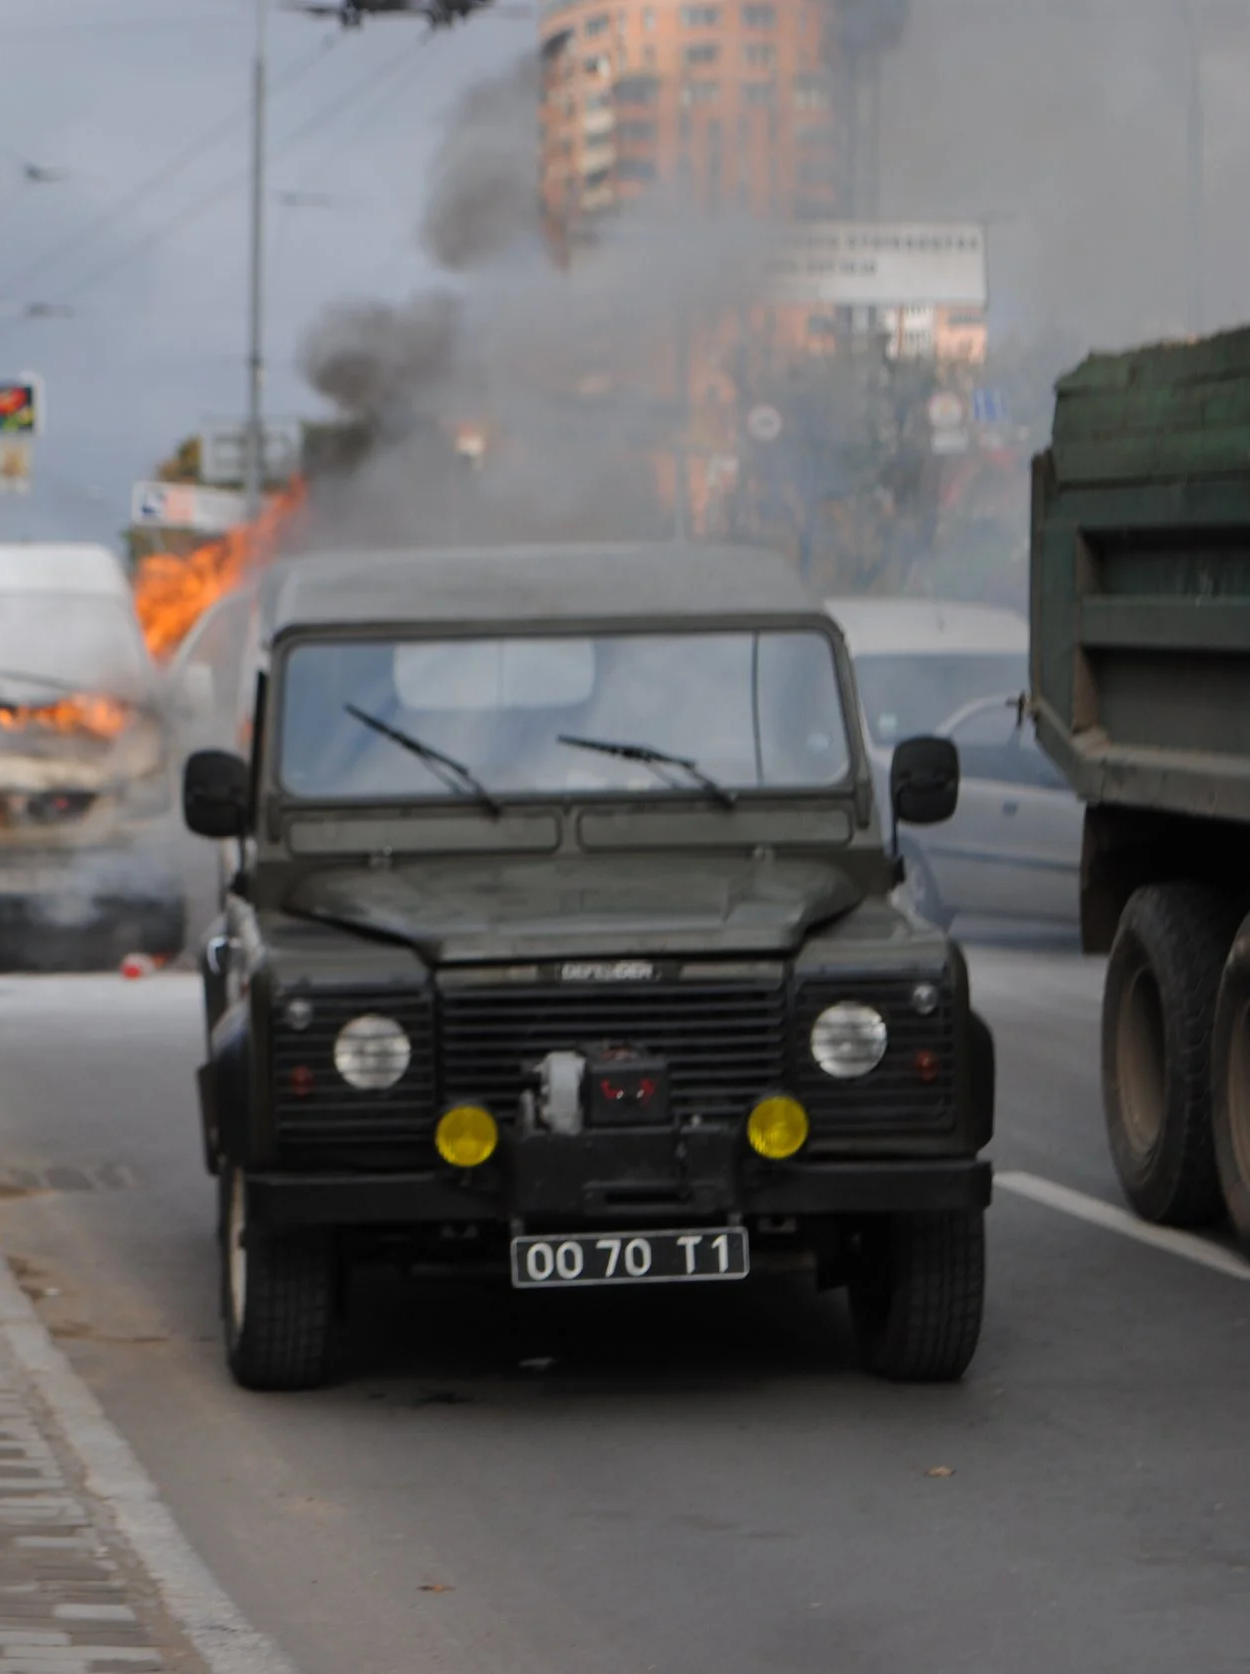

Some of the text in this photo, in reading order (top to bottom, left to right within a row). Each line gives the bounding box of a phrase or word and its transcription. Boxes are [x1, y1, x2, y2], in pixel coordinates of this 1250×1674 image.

[526, 1234, 729, 1281] 00 70 T1
